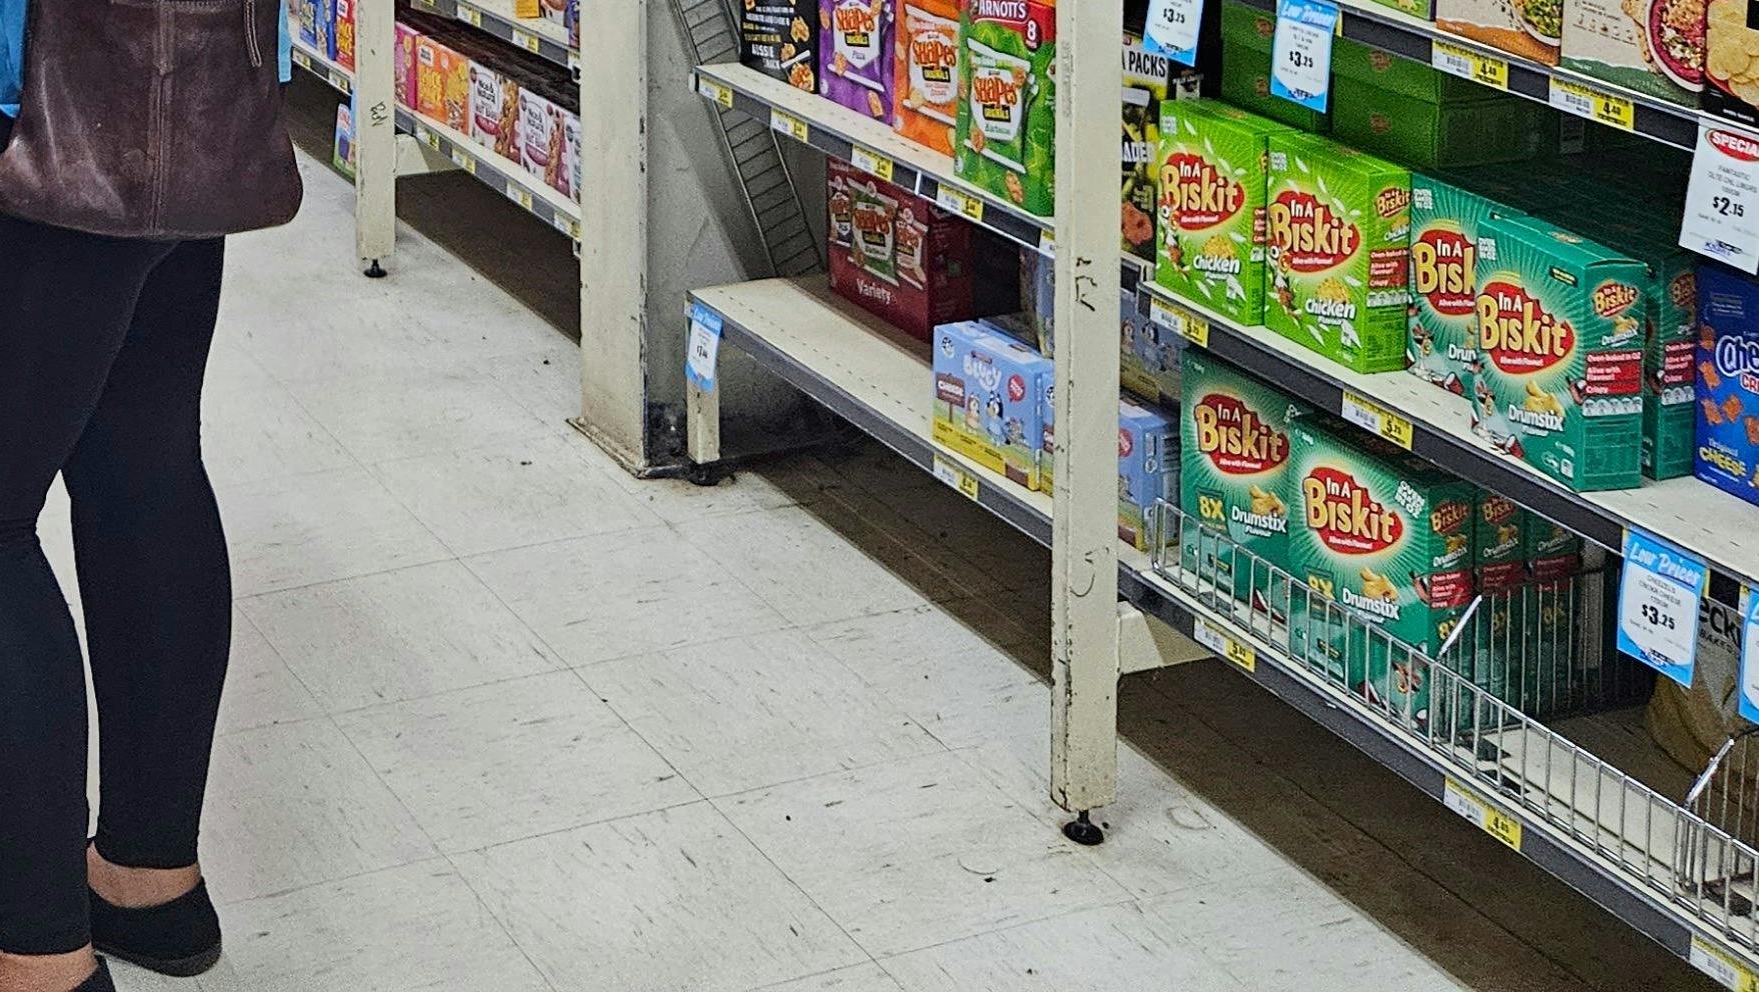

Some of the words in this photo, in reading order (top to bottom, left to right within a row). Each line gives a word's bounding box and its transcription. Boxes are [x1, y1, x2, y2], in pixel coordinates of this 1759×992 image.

[1162, 7, 1186, 25] $3.25
[1281, 0, 1299, 18] Low
[1300, 4, 1336, 28] Prices
[1026, 20, 1037, 42] 8
[1128, 49, 1167, 80] PACKS
[1288, 49, 1314, 69] $3.25
[1711, 129, 1759, 156] SPECIA
[1160, 164, 1240, 214] Biskit
[1712, 195, 1745, 218] $2.15
[1269, 201, 1353, 257] Biskit
[1193, 254, 1240, 276] Chicken
[856, 277, 891, 306] Variety
[1498, 292, 1512, 311] In
[1512, 295, 1523, 311] A
[1305, 297, 1358, 320] Chicken
[1477, 293, 1567, 359] Biskit
[1508, 404, 1564, 433] Drumstix
[1194, 404, 1282, 463] Biskit
[1699, 446, 1747, 477] CHEESE
[1326, 477, 1340, 496] In
[1340, 481, 1351, 498] A
[1198, 494, 1225, 522] 8X
[1231, 505, 1288, 534] Drumstix
[1303, 477, 1395, 543] Biskit
[1630, 540, 1654, 561] Low
[1657, 556, 1700, 585] Prices
[1342, 587, 1401, 621] Drumstix
[1641, 602, 1676, 630] $3.25
